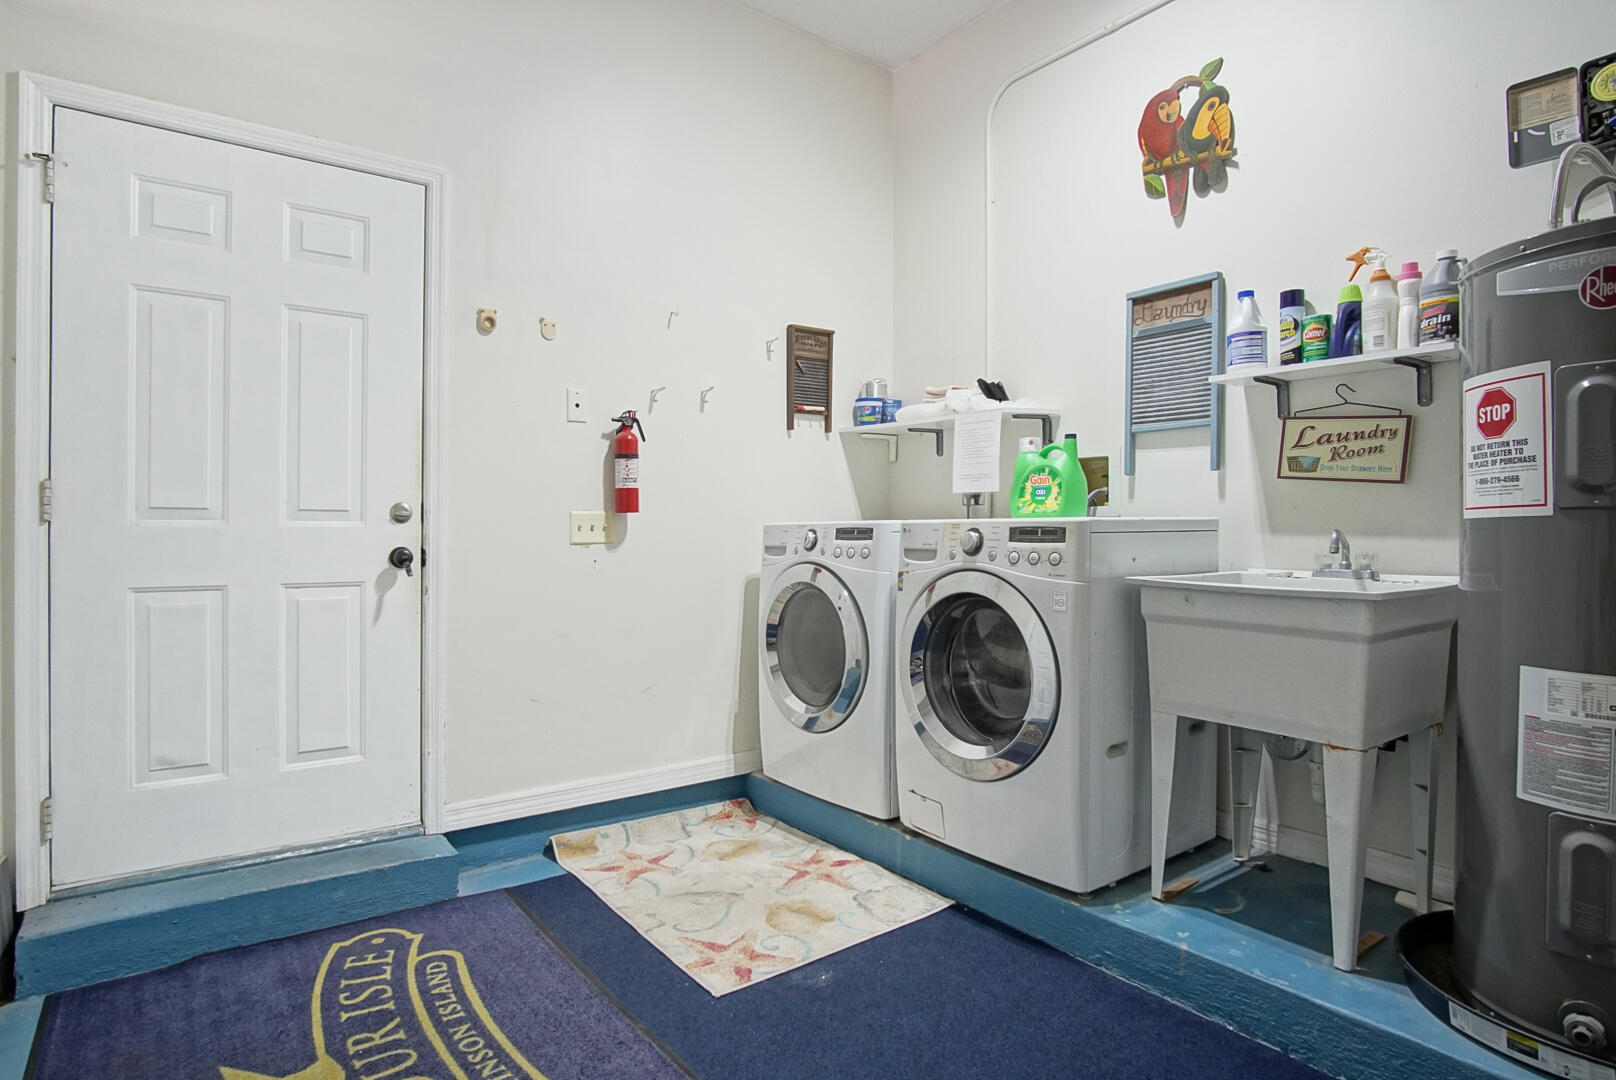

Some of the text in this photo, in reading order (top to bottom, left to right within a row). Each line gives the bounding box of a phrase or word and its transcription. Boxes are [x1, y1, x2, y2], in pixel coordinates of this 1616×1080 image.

[1548, 252, 1616, 273] PERFOR
[1586, 267, 1616, 303] Rhe
[1134, 294, 1207, 326] Laundry
[1420, 313, 1451, 328] drain
[1479, 403, 1511, 424] STOP
[1290, 423, 1400, 450] Laundry
[1487, 440, 1510, 450] RETURN
[1512, 438, 1528, 446] THIS
[1328, 443, 1385, 462] Room
[1472, 447, 1524, 460] WATER HEATER TO
[1474, 459, 1489, 468] PLACE
[1490, 458, 1498, 467] OF
[1499, 454, 1537, 466] PURCHASE
[1320, 463, 1334, 473] Drop
[1335, 463, 1349, 472] Your
[1350, 464, 1376, 473] Drawers
[1030, 473, 1050, 485] Gain
[338, 949, 434, 1080] UR ISLE
[426, 961, 519, 1080] INSON ISLAND
